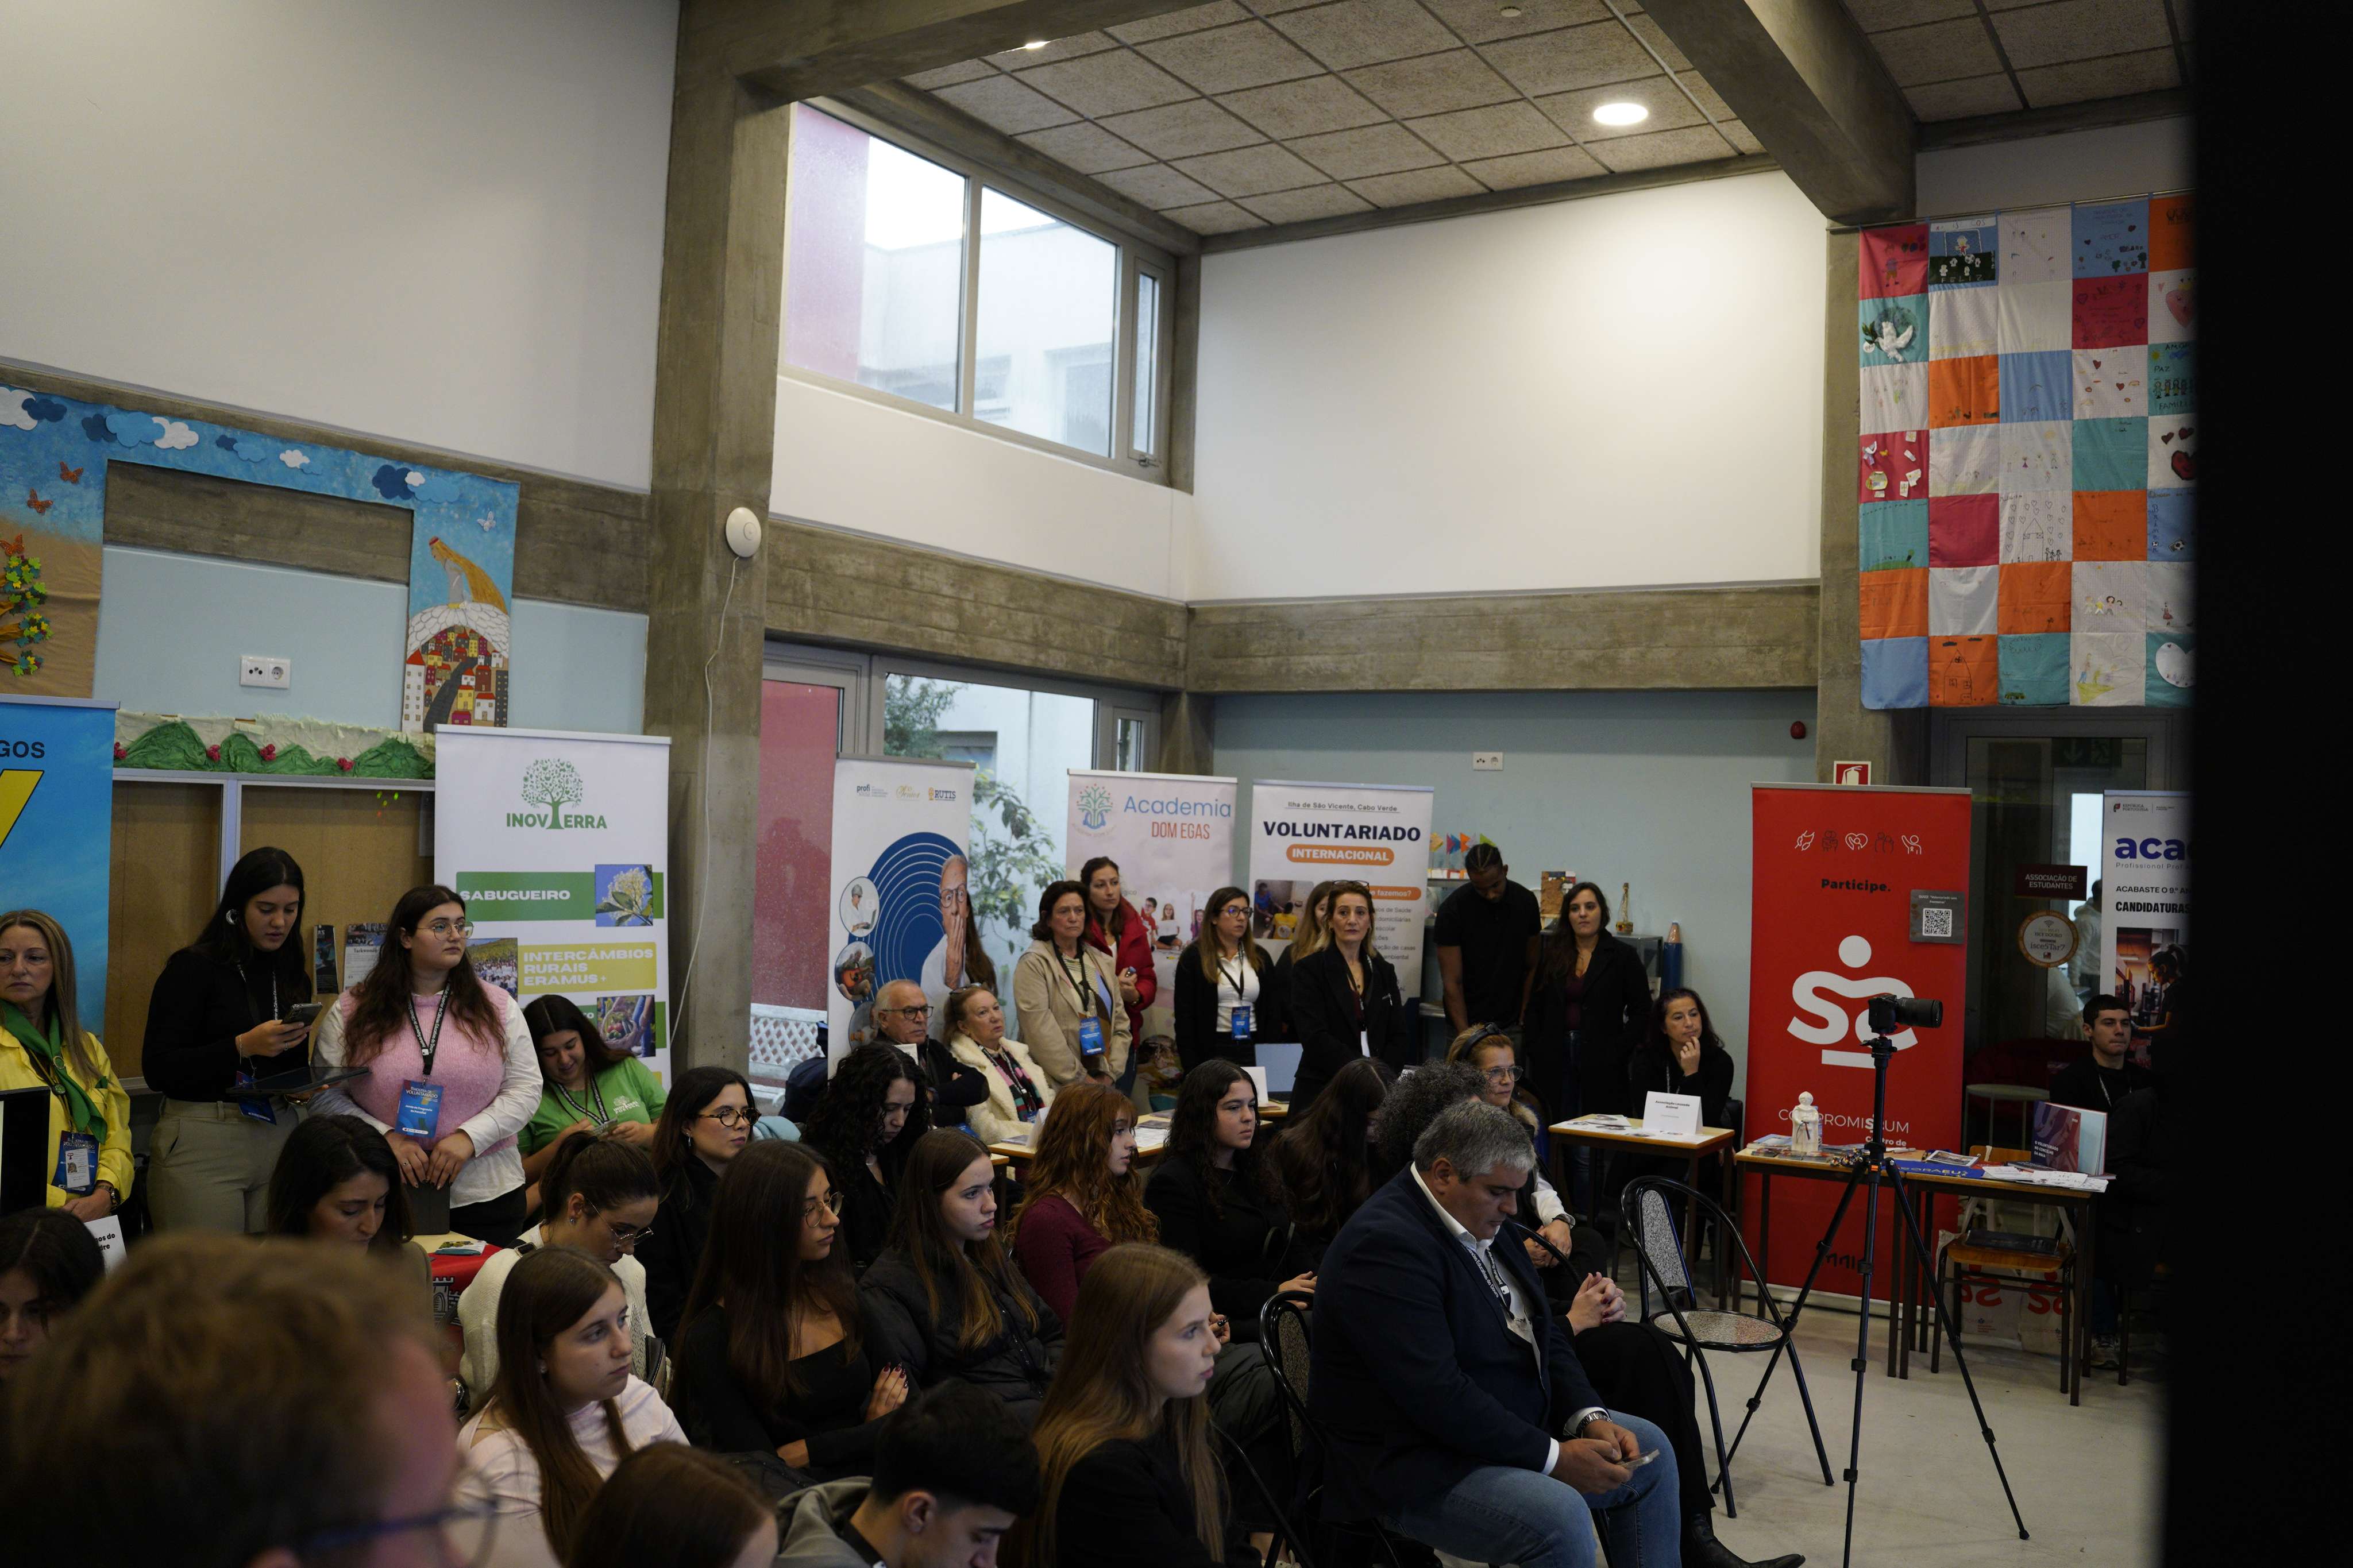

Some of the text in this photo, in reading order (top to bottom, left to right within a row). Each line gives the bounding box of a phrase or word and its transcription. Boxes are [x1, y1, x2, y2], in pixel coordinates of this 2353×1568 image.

[935, 790, 956, 799] RUTIS
[1124, 796, 1231, 818] Academia
[1152, 821, 1210, 840] DOM EGAS
[1263, 821, 1421, 841] VOLUNTARIADO
[1292, 848, 1390, 862] INTERNACIONAL
[2026, 874, 2067, 883] ASSOCIAÇÃO
[1821, 879, 1891, 893] Participe.
[2029, 881, 2073, 890] ESTUDANTES
[461, 890, 571, 901] SABUGUEIRO
[523, 948, 653, 961] INTERCÂMBIOS
[524, 963, 588, 974] RURAIS
